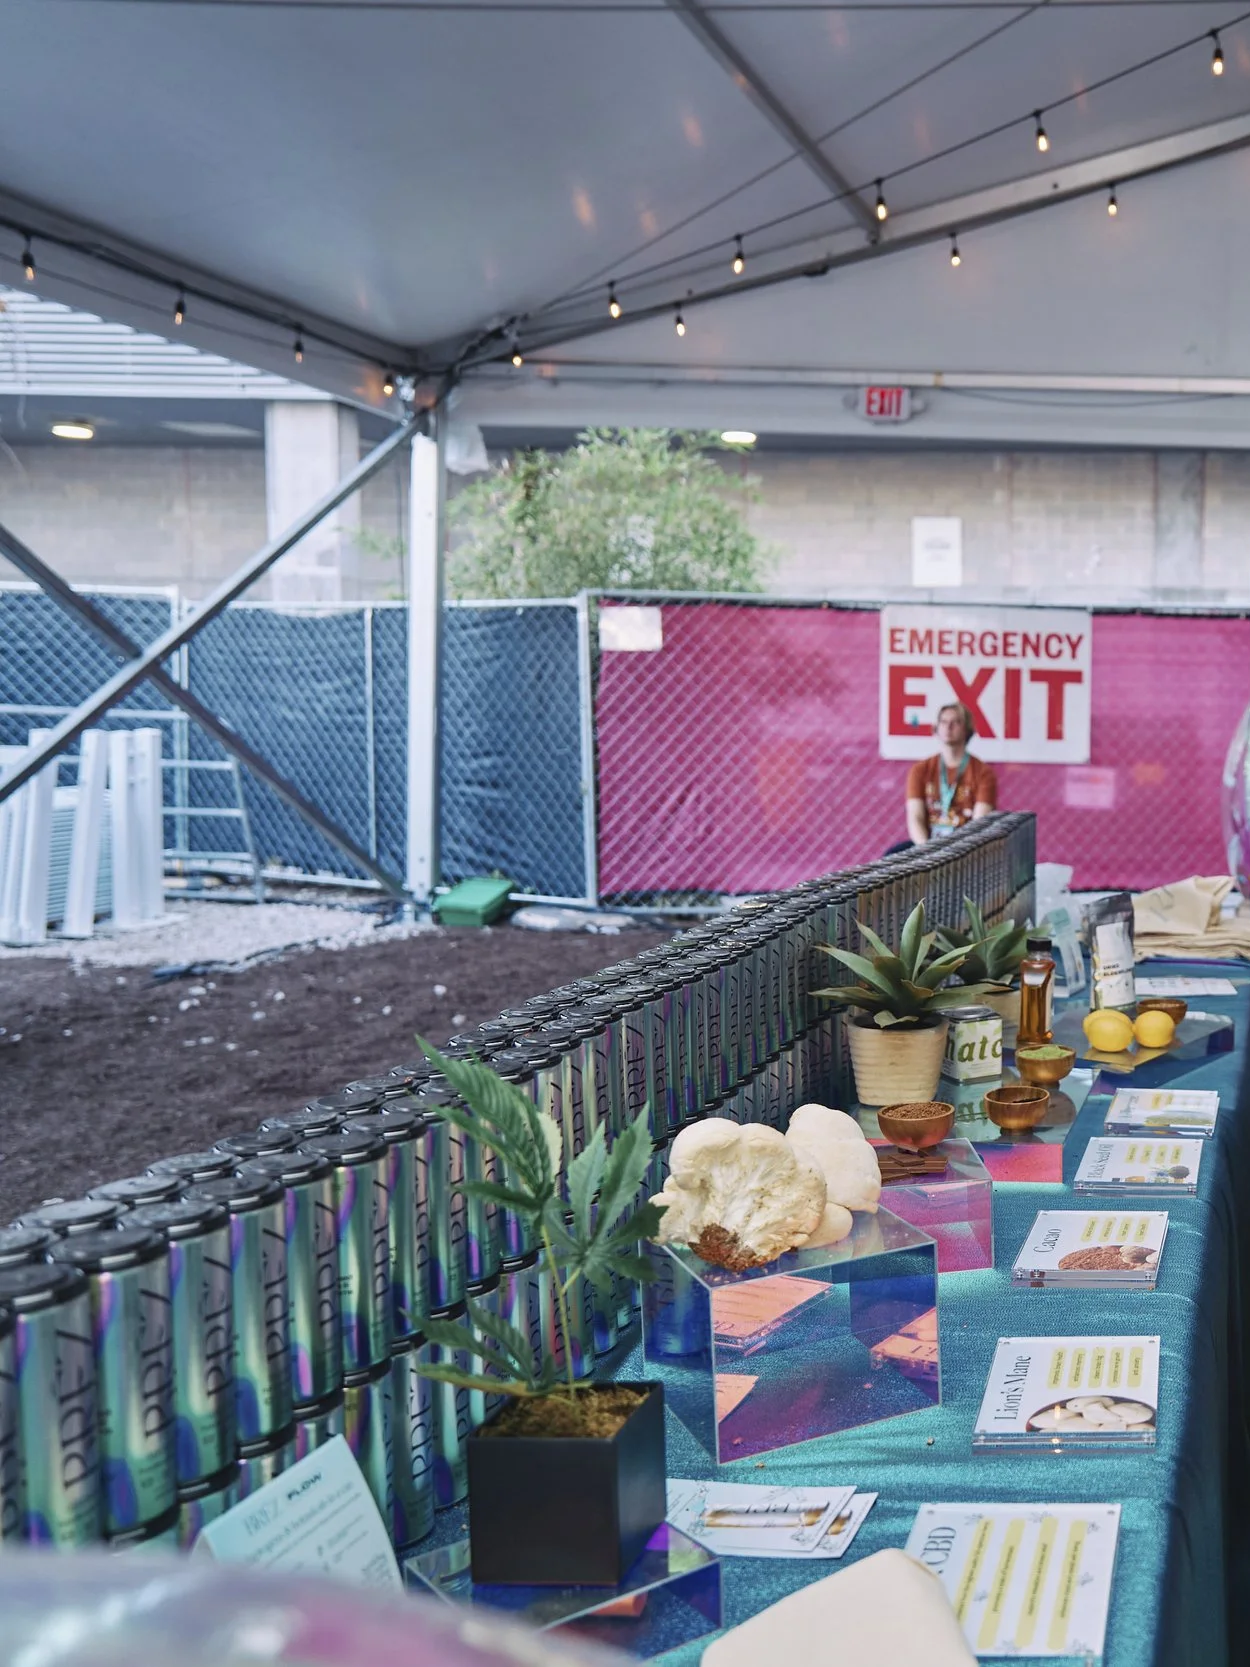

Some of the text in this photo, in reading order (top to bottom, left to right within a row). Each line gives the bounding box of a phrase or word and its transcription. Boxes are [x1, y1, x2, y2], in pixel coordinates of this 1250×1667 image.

[889, 628, 1084, 661] EMERGENCY
[888, 664, 1083, 741] EXIT
[1033, 1228, 1062, 1253] Cacao
[994, 1355, 1032, 1421] Lion's Mane
[920, 1526, 957, 1566] CBD
